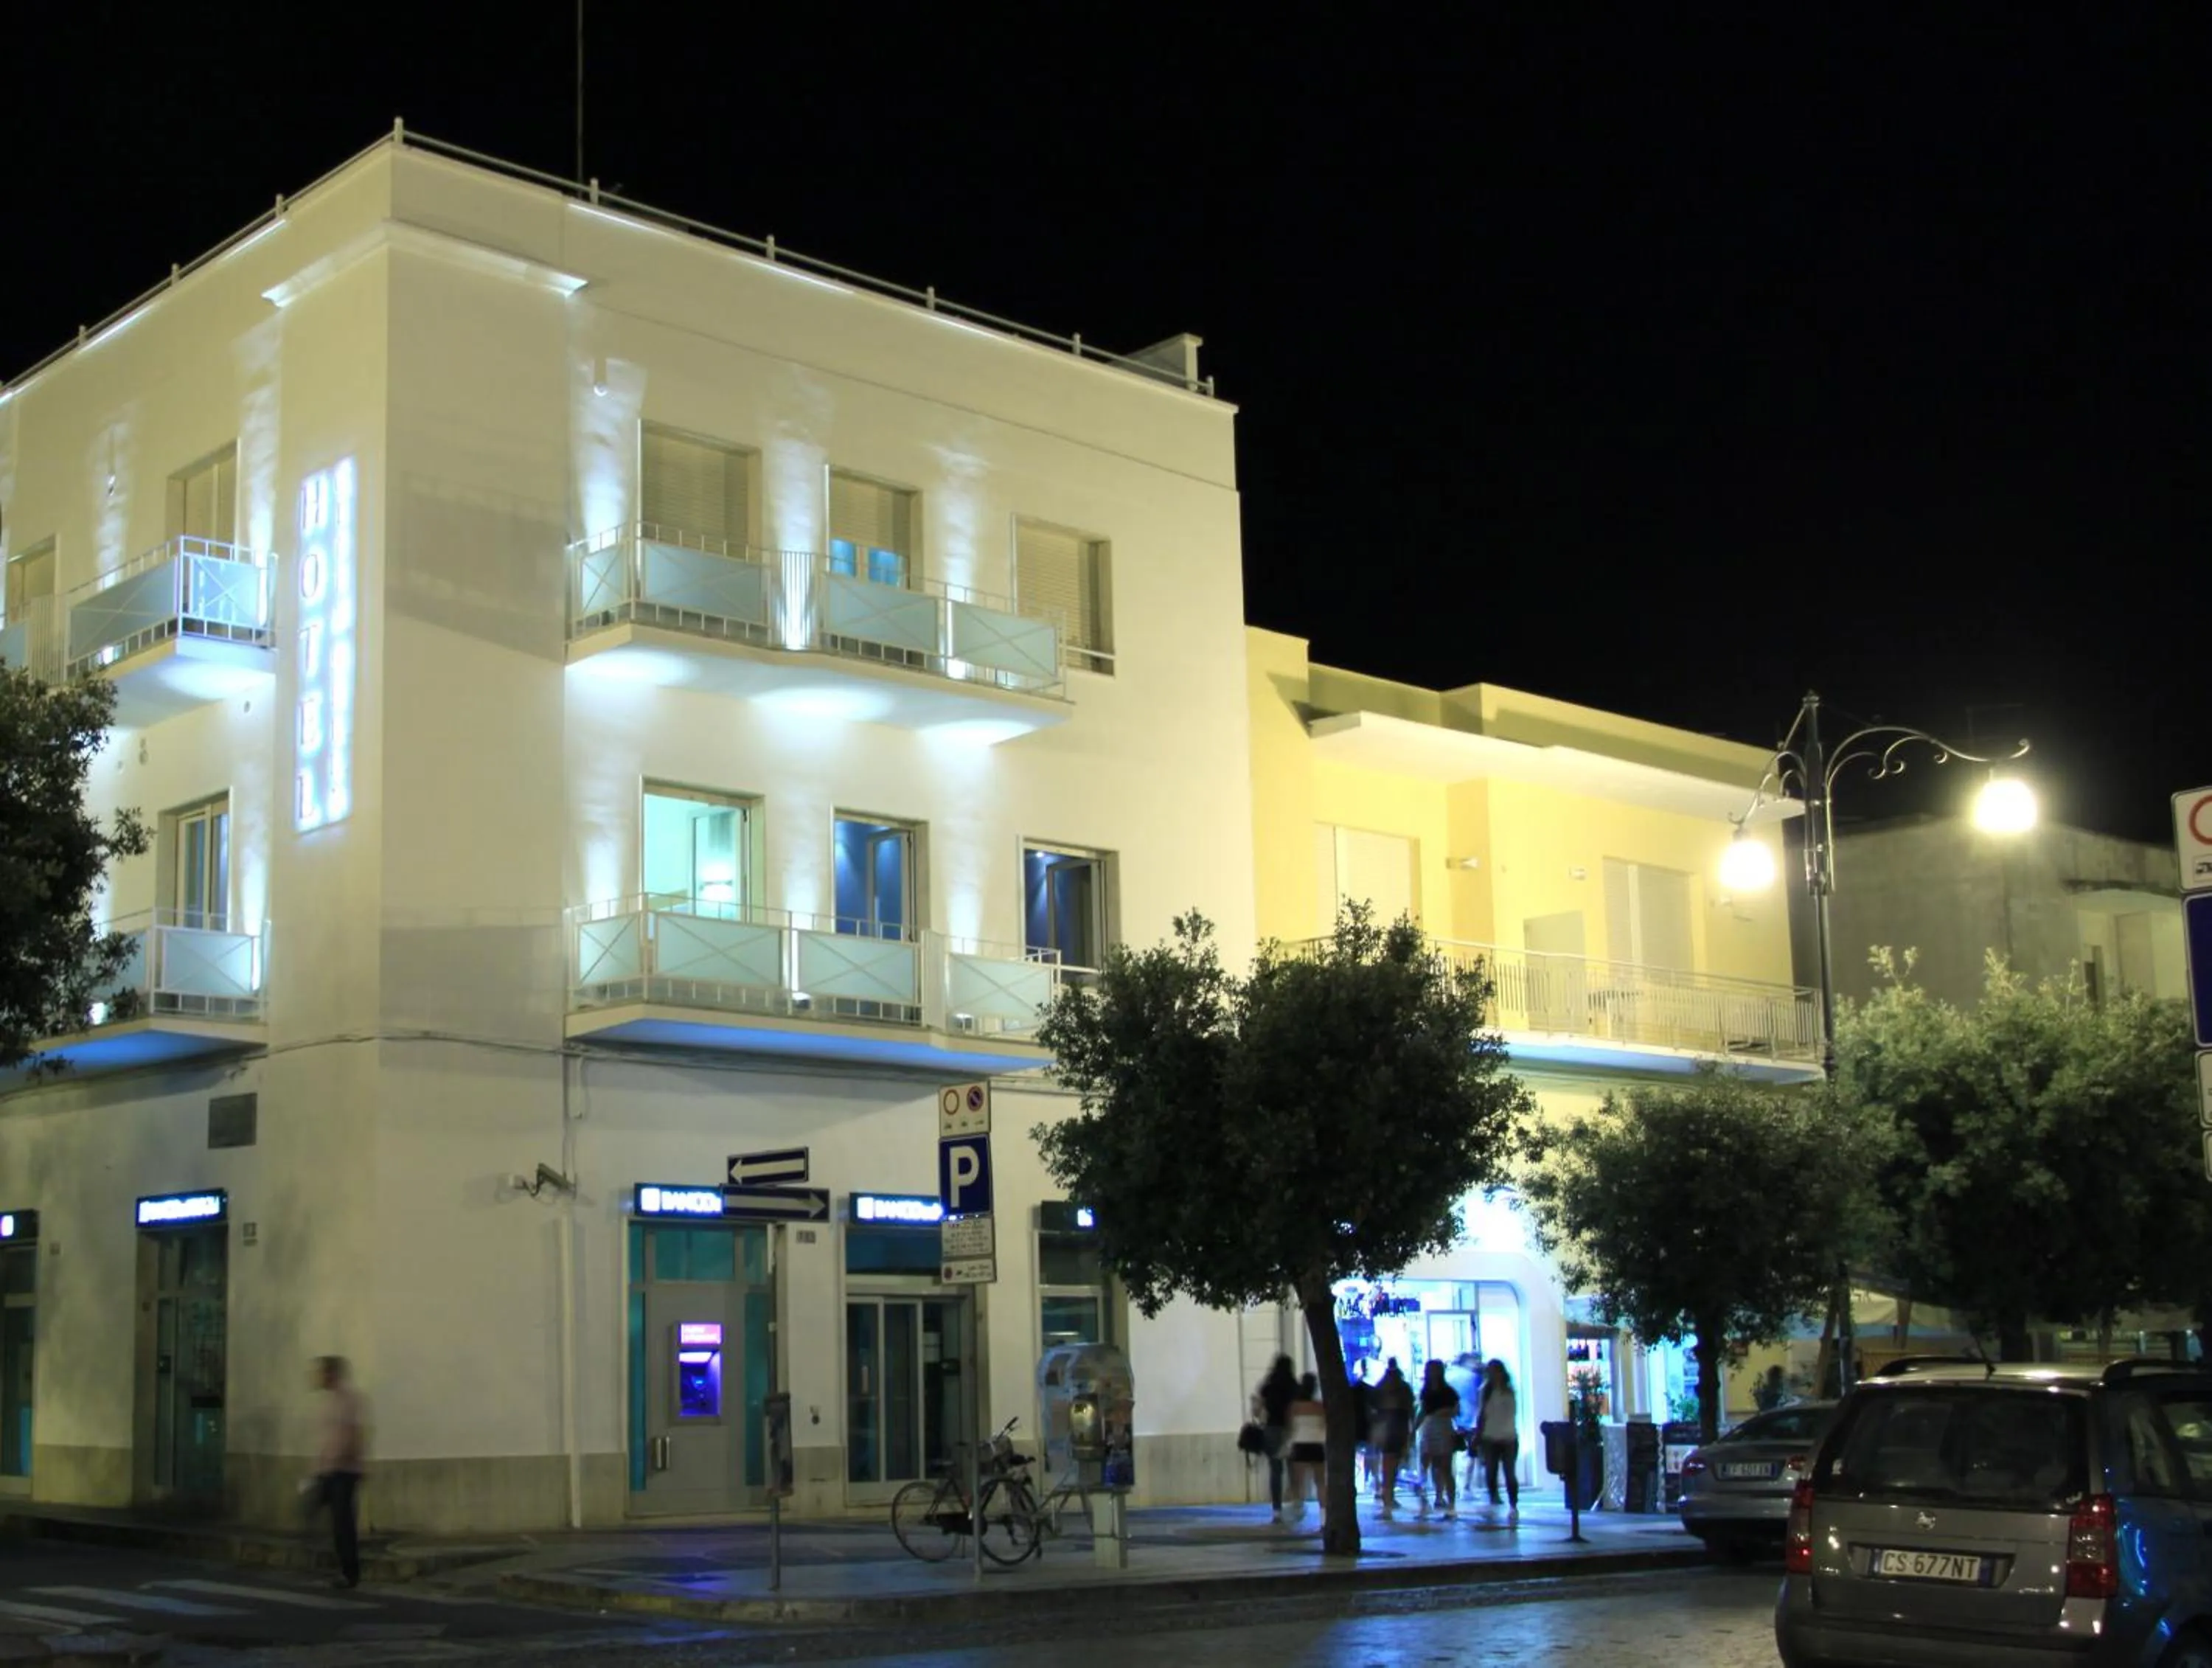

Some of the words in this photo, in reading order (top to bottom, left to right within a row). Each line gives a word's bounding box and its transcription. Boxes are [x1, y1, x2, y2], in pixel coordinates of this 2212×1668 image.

[296, 477, 326, 821] HOTEL
[949, 1145, 981, 1209] P
[1883, 1552, 1906, 1572] CS
[1913, 1554, 1978, 1579] 677NT
